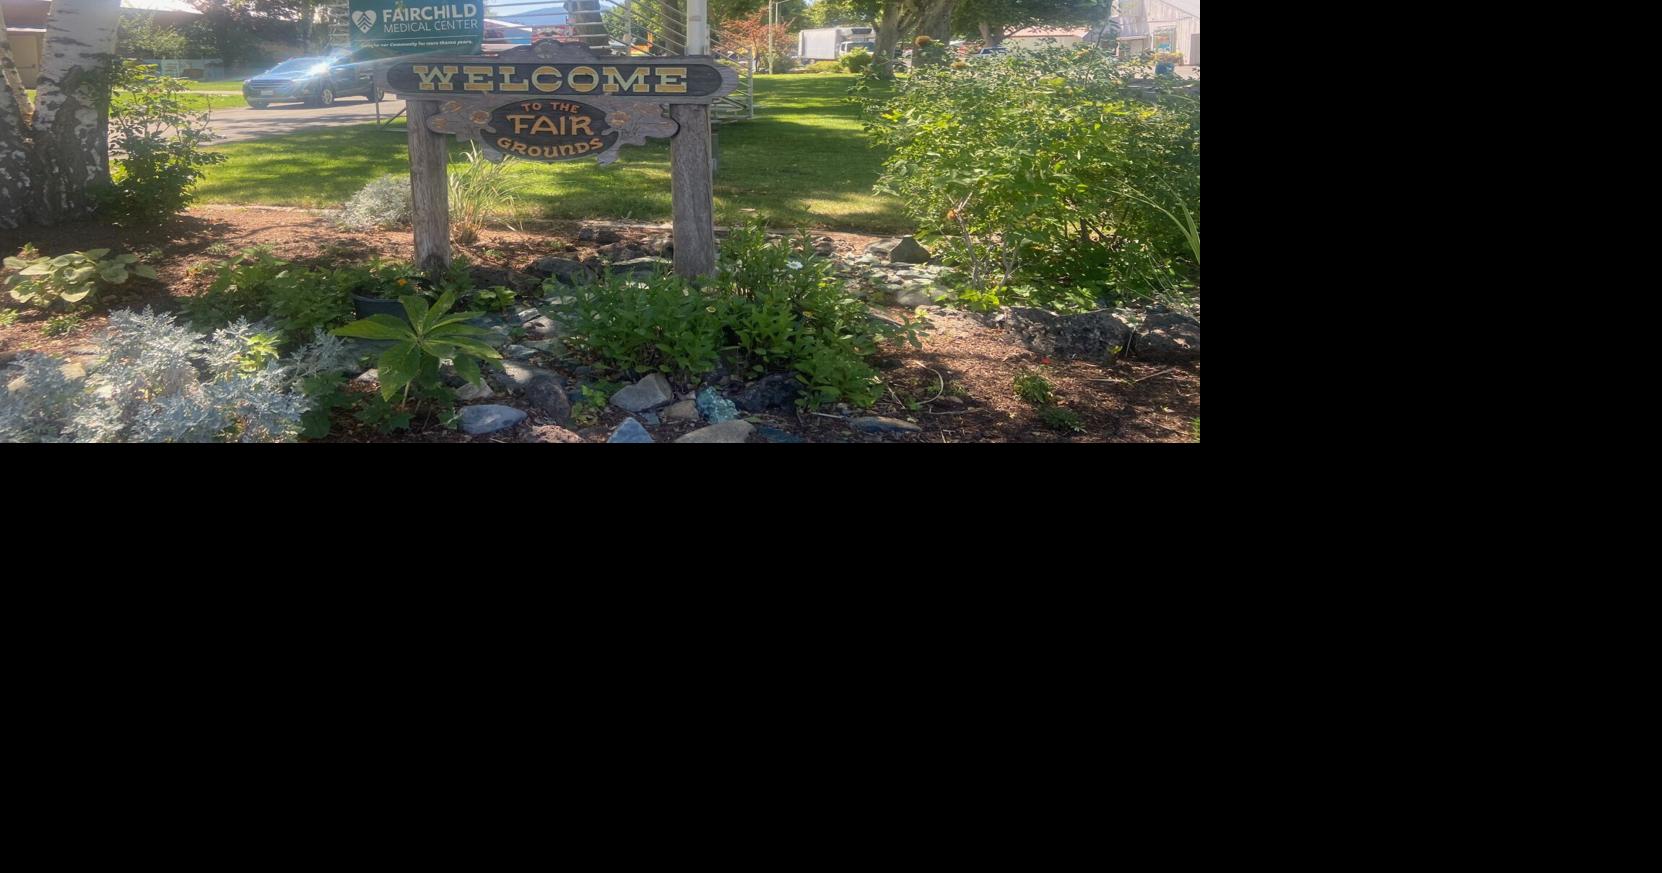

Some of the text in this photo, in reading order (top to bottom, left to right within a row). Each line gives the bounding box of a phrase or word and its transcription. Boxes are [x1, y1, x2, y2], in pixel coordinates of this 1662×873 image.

[382, 3, 477, 22] FAIRCHILD
[384, 19, 478, 33] MEDICAL CENTER
[413, 65, 687, 93] WELCOME
[521, 102, 580, 113] TO THE
[506, 114, 594, 136] FAIR
[497, 137, 604, 158] GROUNDS
